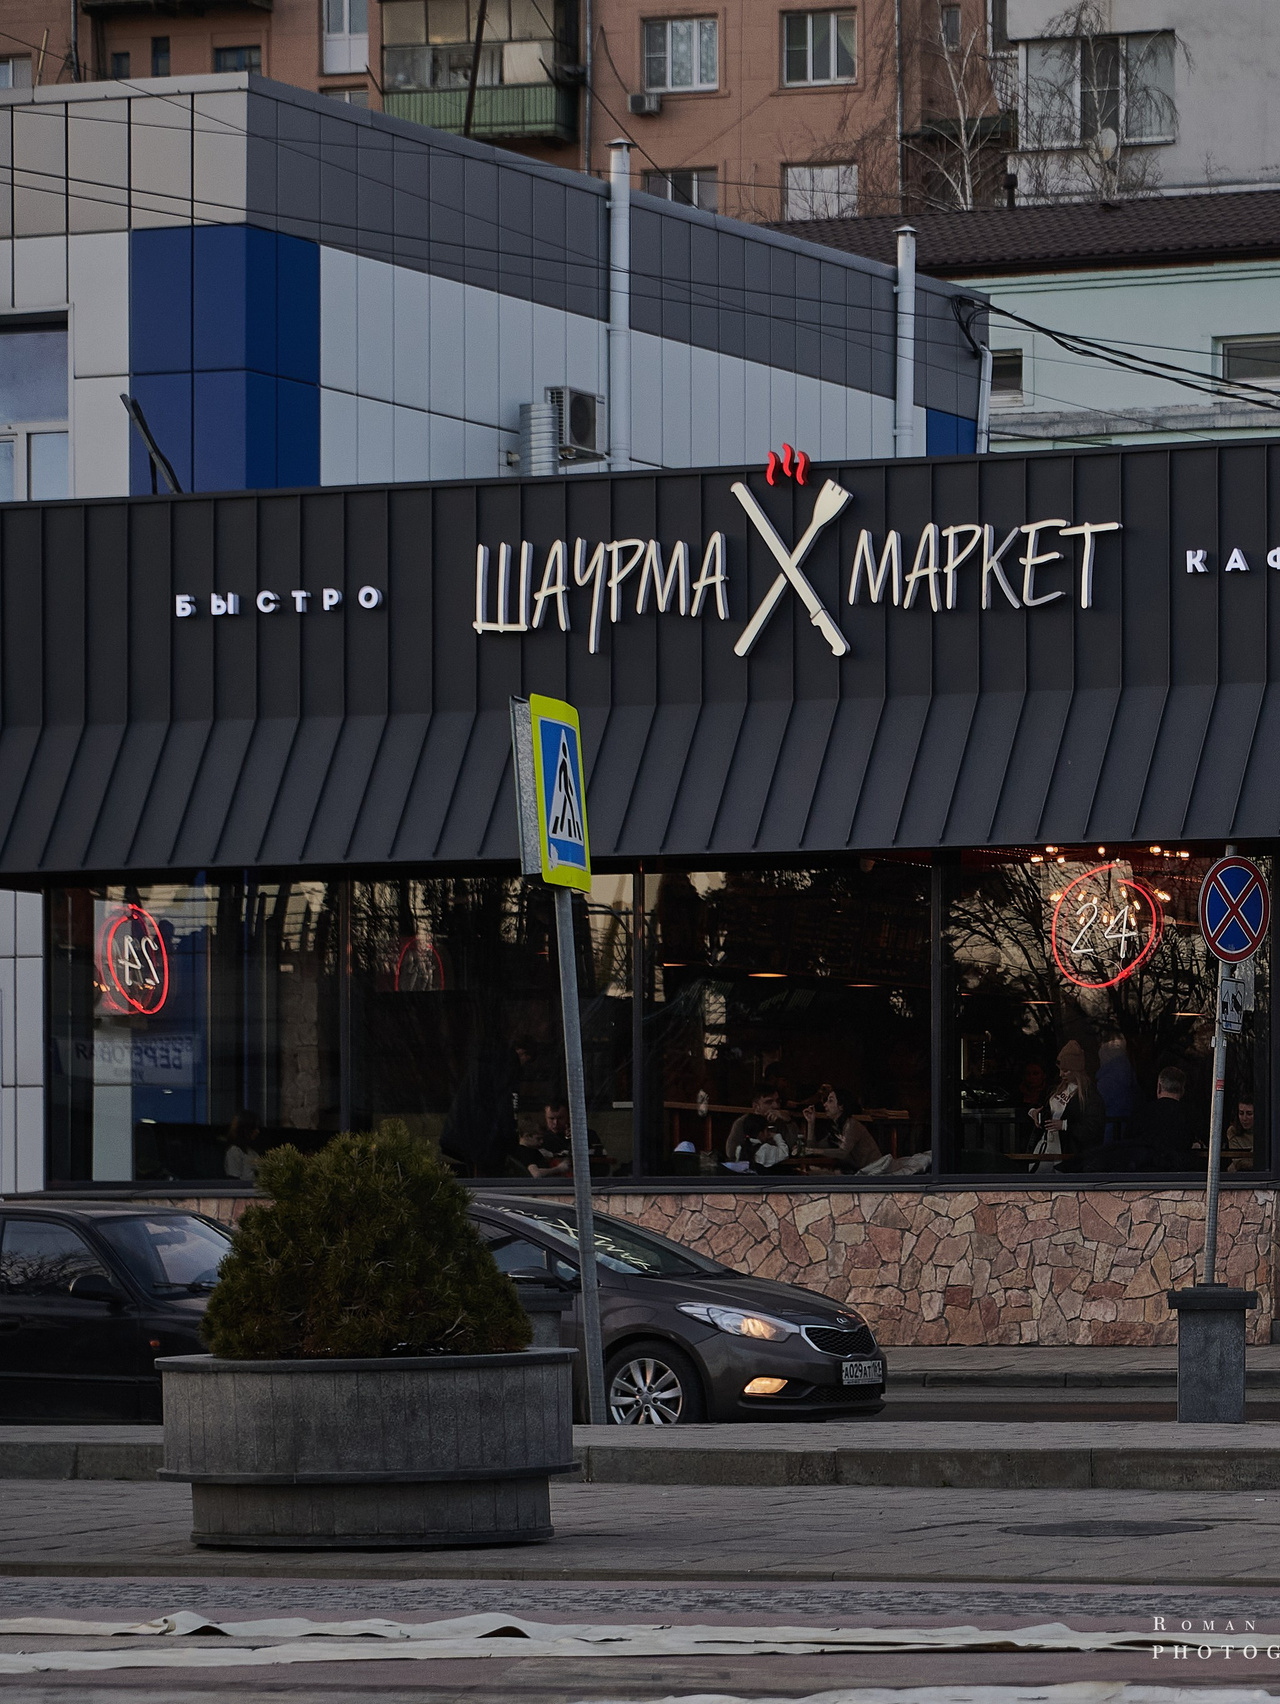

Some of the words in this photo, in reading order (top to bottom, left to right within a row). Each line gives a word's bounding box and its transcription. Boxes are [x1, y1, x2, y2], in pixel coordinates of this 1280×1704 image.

[174, 584, 387, 618] БЫСТРО
[472, 530, 729, 655] ШАУРМА
[848, 519, 1124, 613] МАРКЕТ
[1070, 902, 1138, 959] 24
